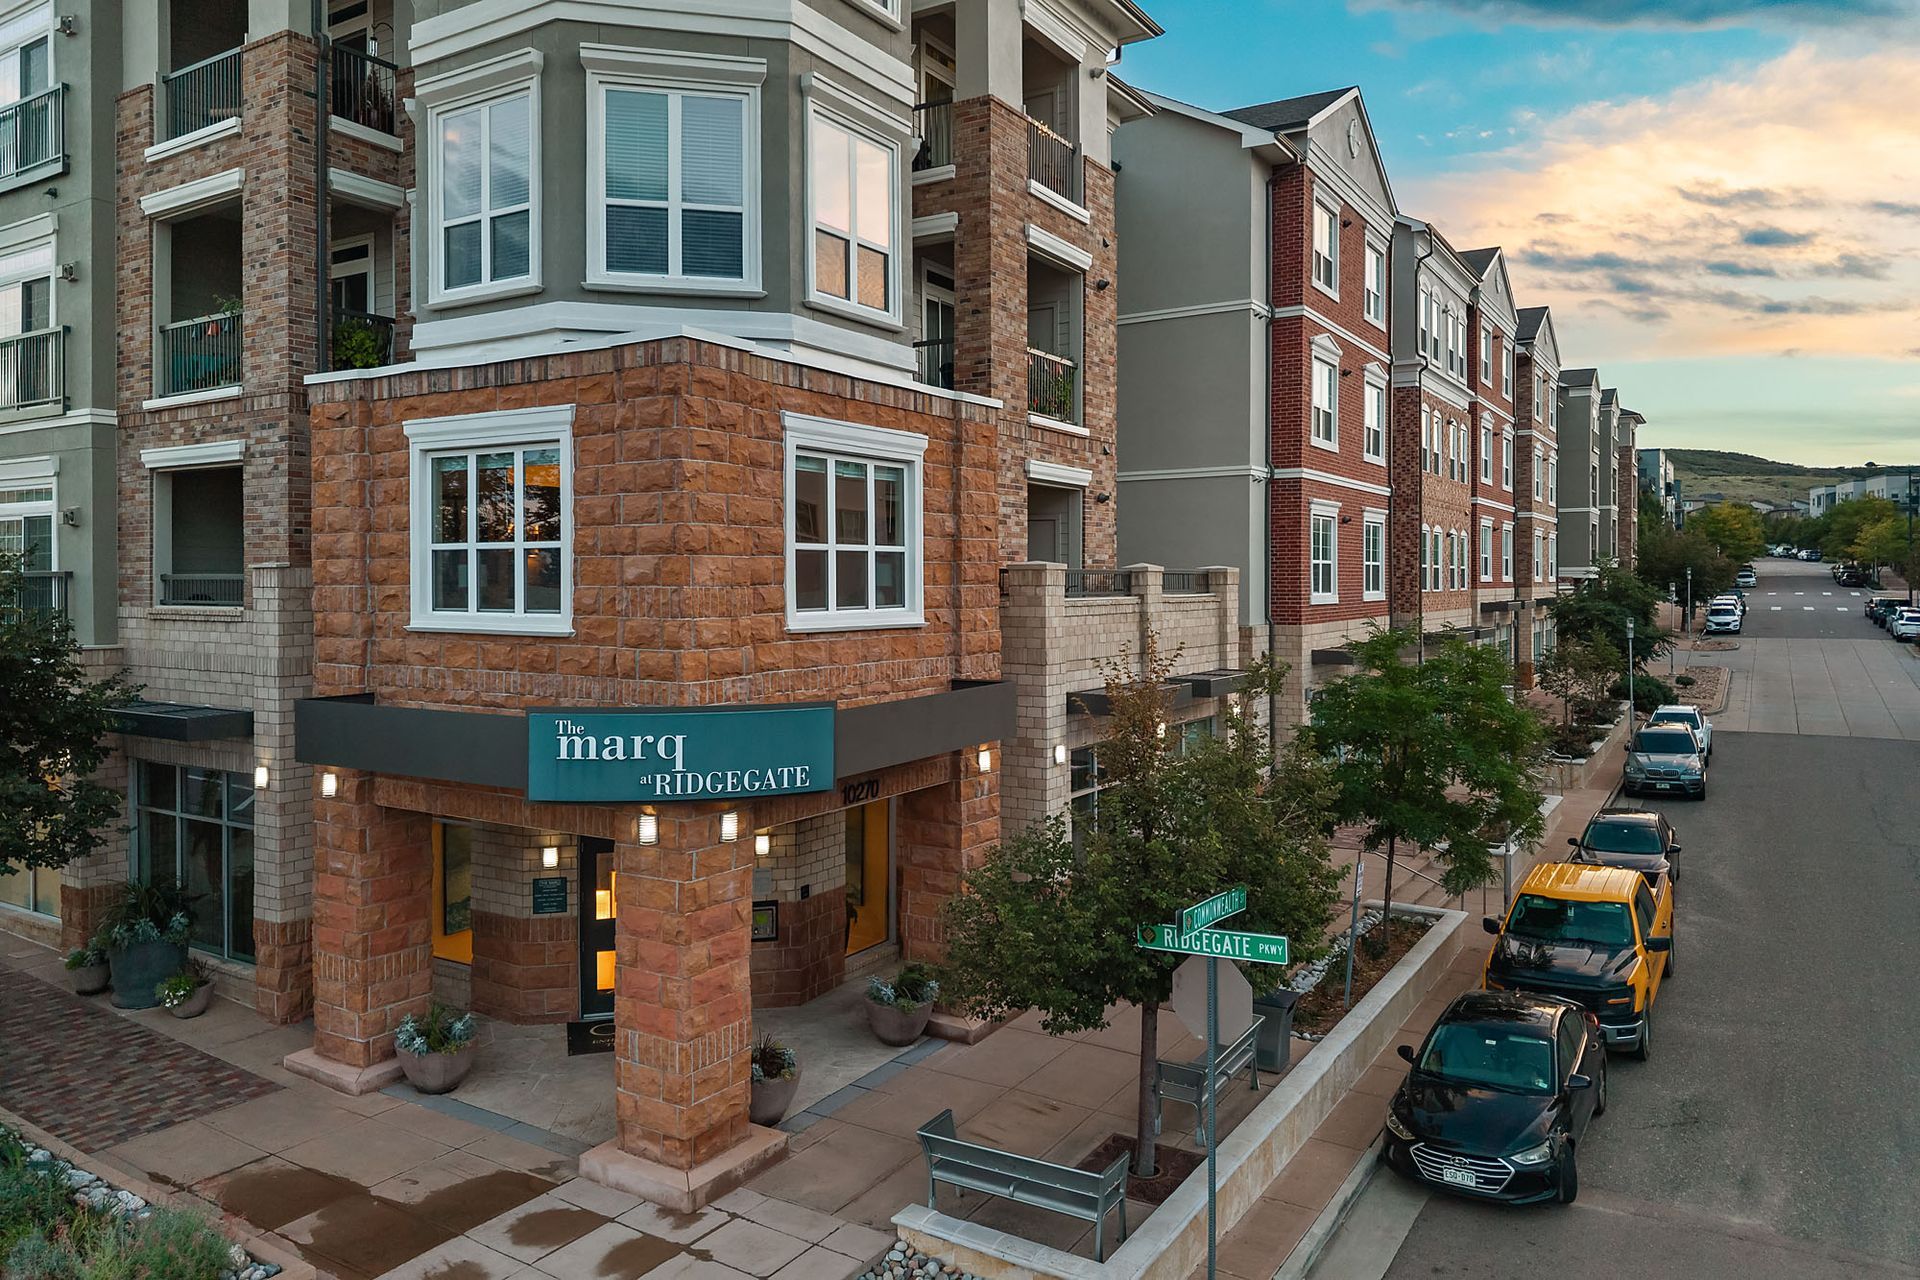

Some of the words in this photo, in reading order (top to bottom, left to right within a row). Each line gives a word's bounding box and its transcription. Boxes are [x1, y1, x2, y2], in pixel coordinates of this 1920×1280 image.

[555, 719, 584, 734] The
[556, 734, 687, 771] marq
[640, 775, 652, 784] at
[653, 765, 810, 796] RIDGEGATE
[841, 779, 879, 805] 10270
[1193, 890, 1239, 929] COMMONWEALTH
[1164, 928, 1252, 957] RIDGEGATE
[1258, 943, 1284, 956] PKWY
